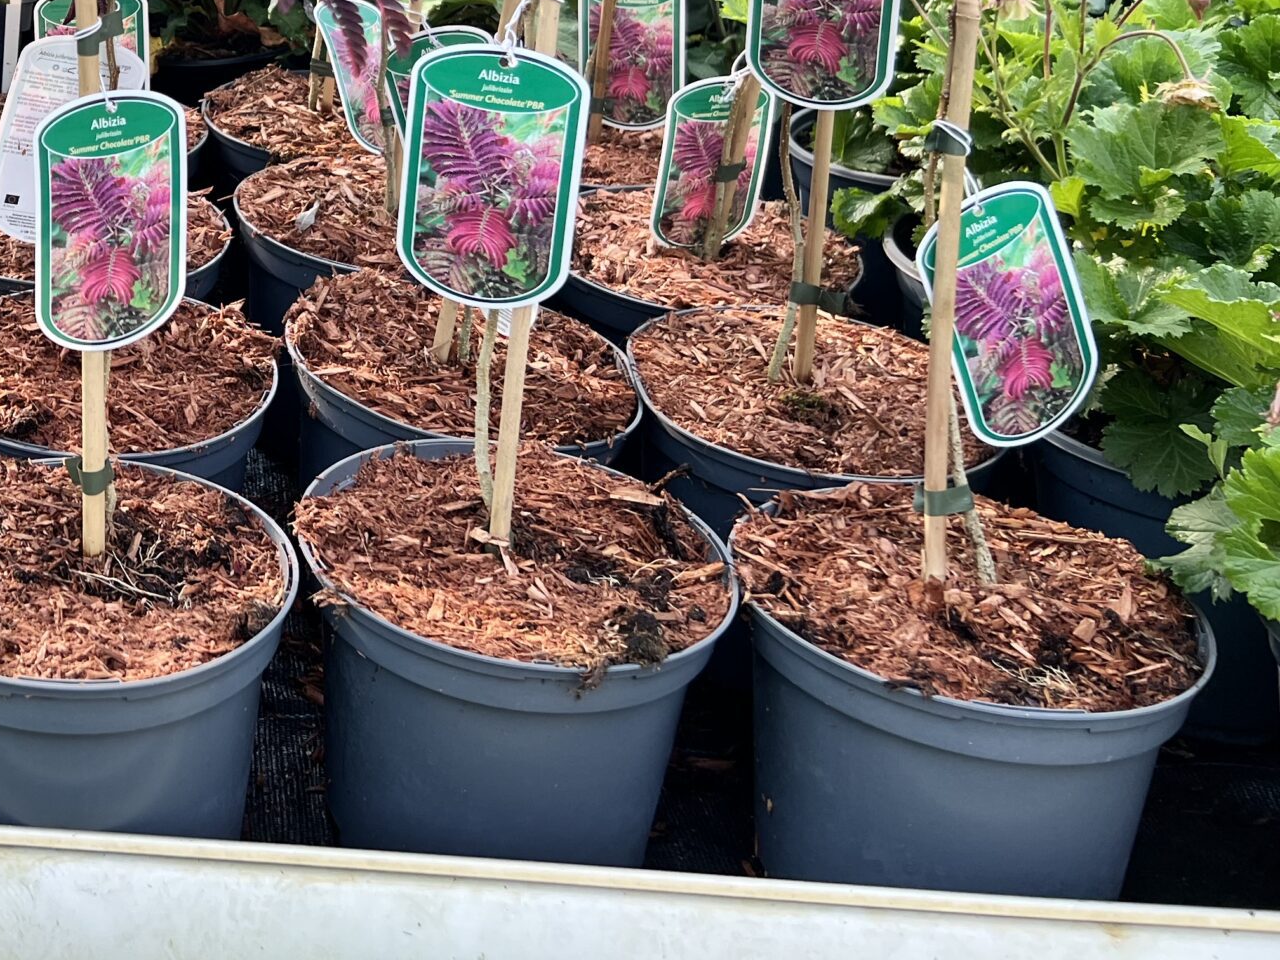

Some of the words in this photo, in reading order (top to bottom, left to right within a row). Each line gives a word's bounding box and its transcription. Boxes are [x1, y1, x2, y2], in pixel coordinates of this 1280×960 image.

[478, 69, 520, 85] Albizia
[449, 89, 483, 102] 'Summer
[90, 116, 126, 130] Albizia
[68, 143, 99, 155] 'Summer
[965, 215, 998, 238] Albizia
